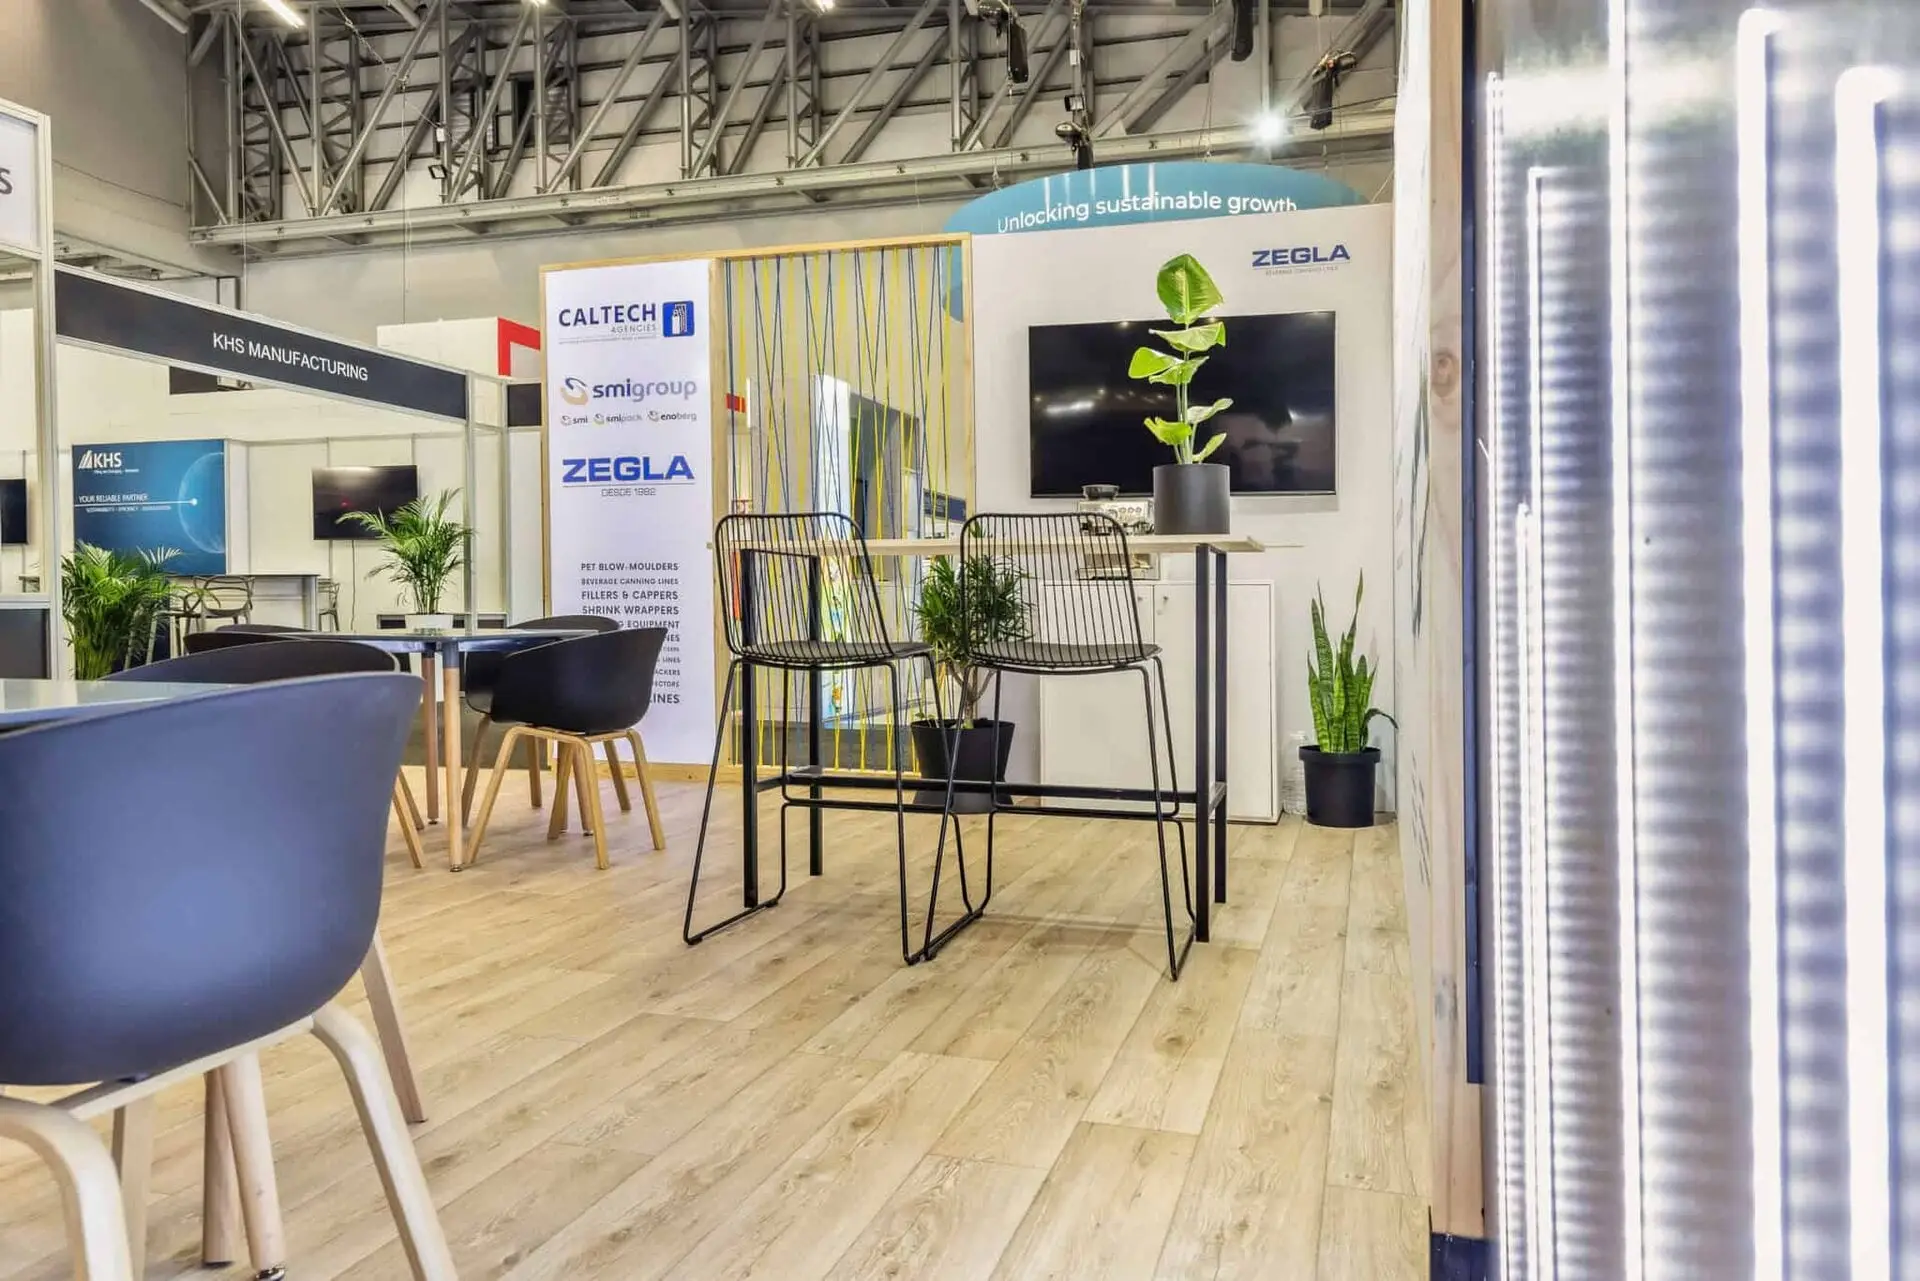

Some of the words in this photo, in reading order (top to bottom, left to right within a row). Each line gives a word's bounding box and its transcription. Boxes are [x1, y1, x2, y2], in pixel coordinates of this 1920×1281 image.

[998, 202, 1089, 233] Unlocking
[1095, 191, 1222, 215] sustainable
[1228, 197, 1298, 214] growth
[1252, 244, 1350, 267] ZEGLA
[559, 303, 656, 327] CALTECH
[611, 324, 657, 334] AGENCIES
[212, 332, 245, 354] KHS
[248, 341, 369, 381] MANUFACTURING
[592, 378, 697, 402] smigroup
[94, 452, 122, 468] KHS
[562, 456, 695, 483] ZEGLA
[581, 562, 596, 571] PET
[581, 578, 618, 586] BEVERAGE
[582, 590, 619, 600] FILLERS
[622, 590, 629, 600] &
[632, 590, 679, 600] CAPPERS
[582, 605, 621, 615] SHRINK
[624, 605, 680, 615] WRAPPERS
[627, 620, 680, 629] EQUIPMENT
[650, 694, 680, 704] INES
